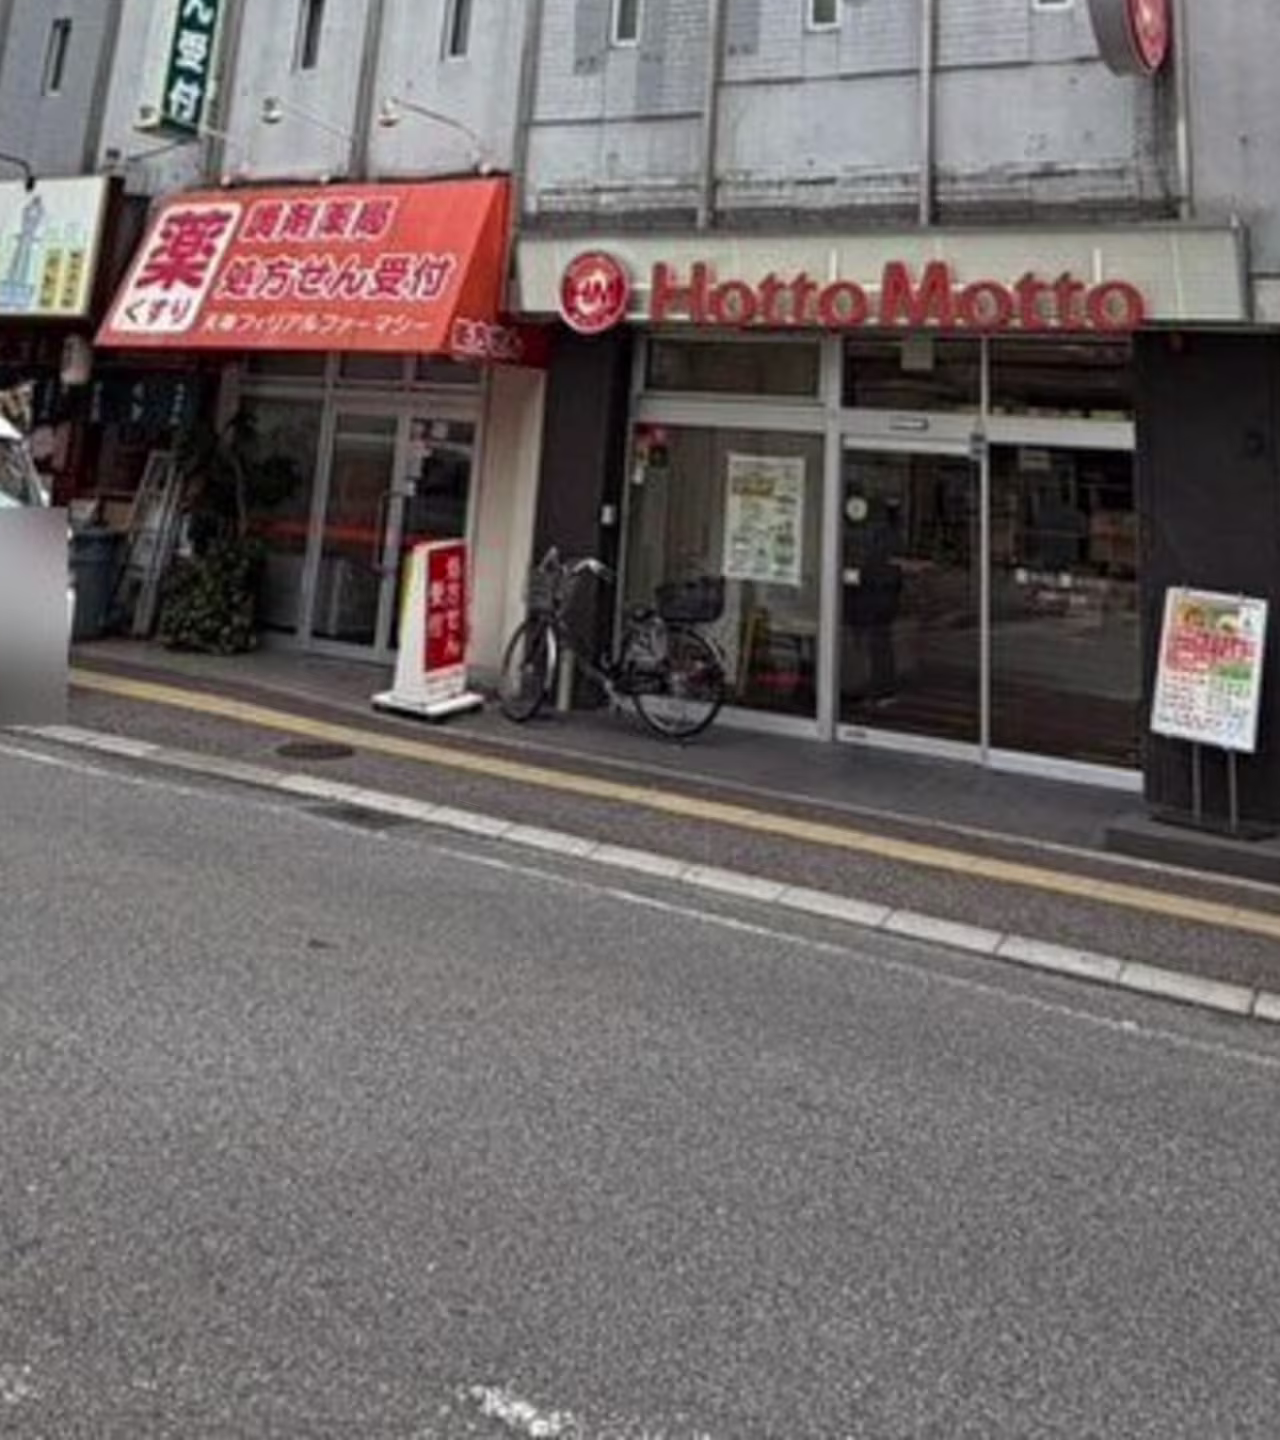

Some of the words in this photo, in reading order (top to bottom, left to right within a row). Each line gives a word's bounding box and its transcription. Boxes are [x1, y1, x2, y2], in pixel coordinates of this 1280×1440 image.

[138, 211, 230, 289] 薬
[222, 257, 451, 300] 処方せん受付
[125, 298, 192, 324] くすり
[648, 261, 869, 330] Hotto
[879, 261, 1145, 332] Motto
